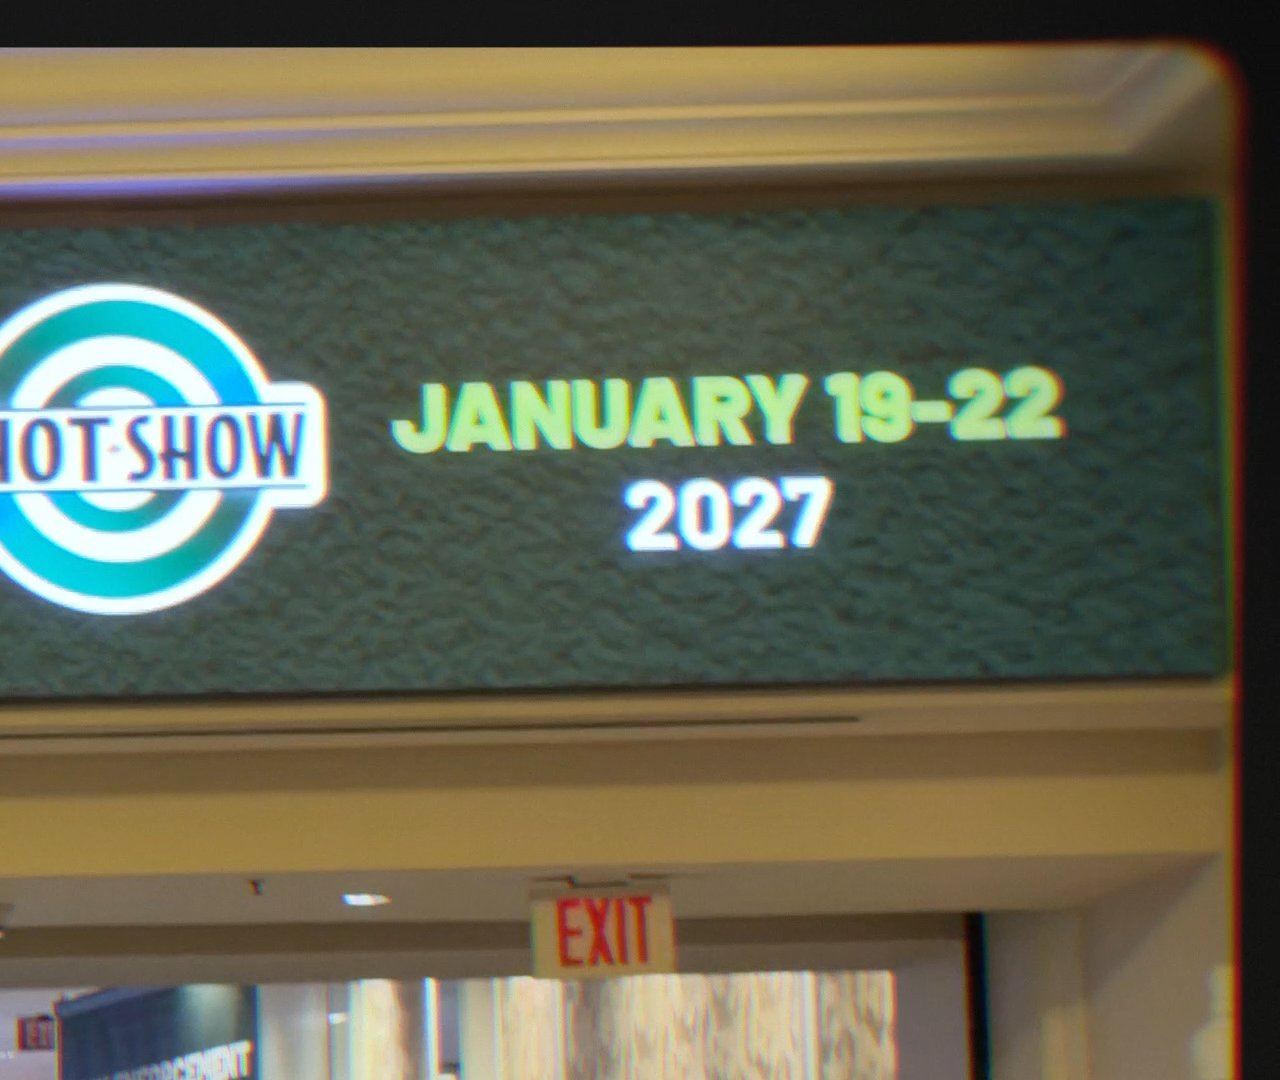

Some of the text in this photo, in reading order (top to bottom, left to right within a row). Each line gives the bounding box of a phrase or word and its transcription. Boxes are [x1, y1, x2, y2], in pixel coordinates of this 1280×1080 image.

[125, 412, 306, 483] SHOW
[391, 365, 1067, 455] JANUARY 19-22
[624, 475, 835, 552] 2027
[555, 895, 652, 968] EXIT
